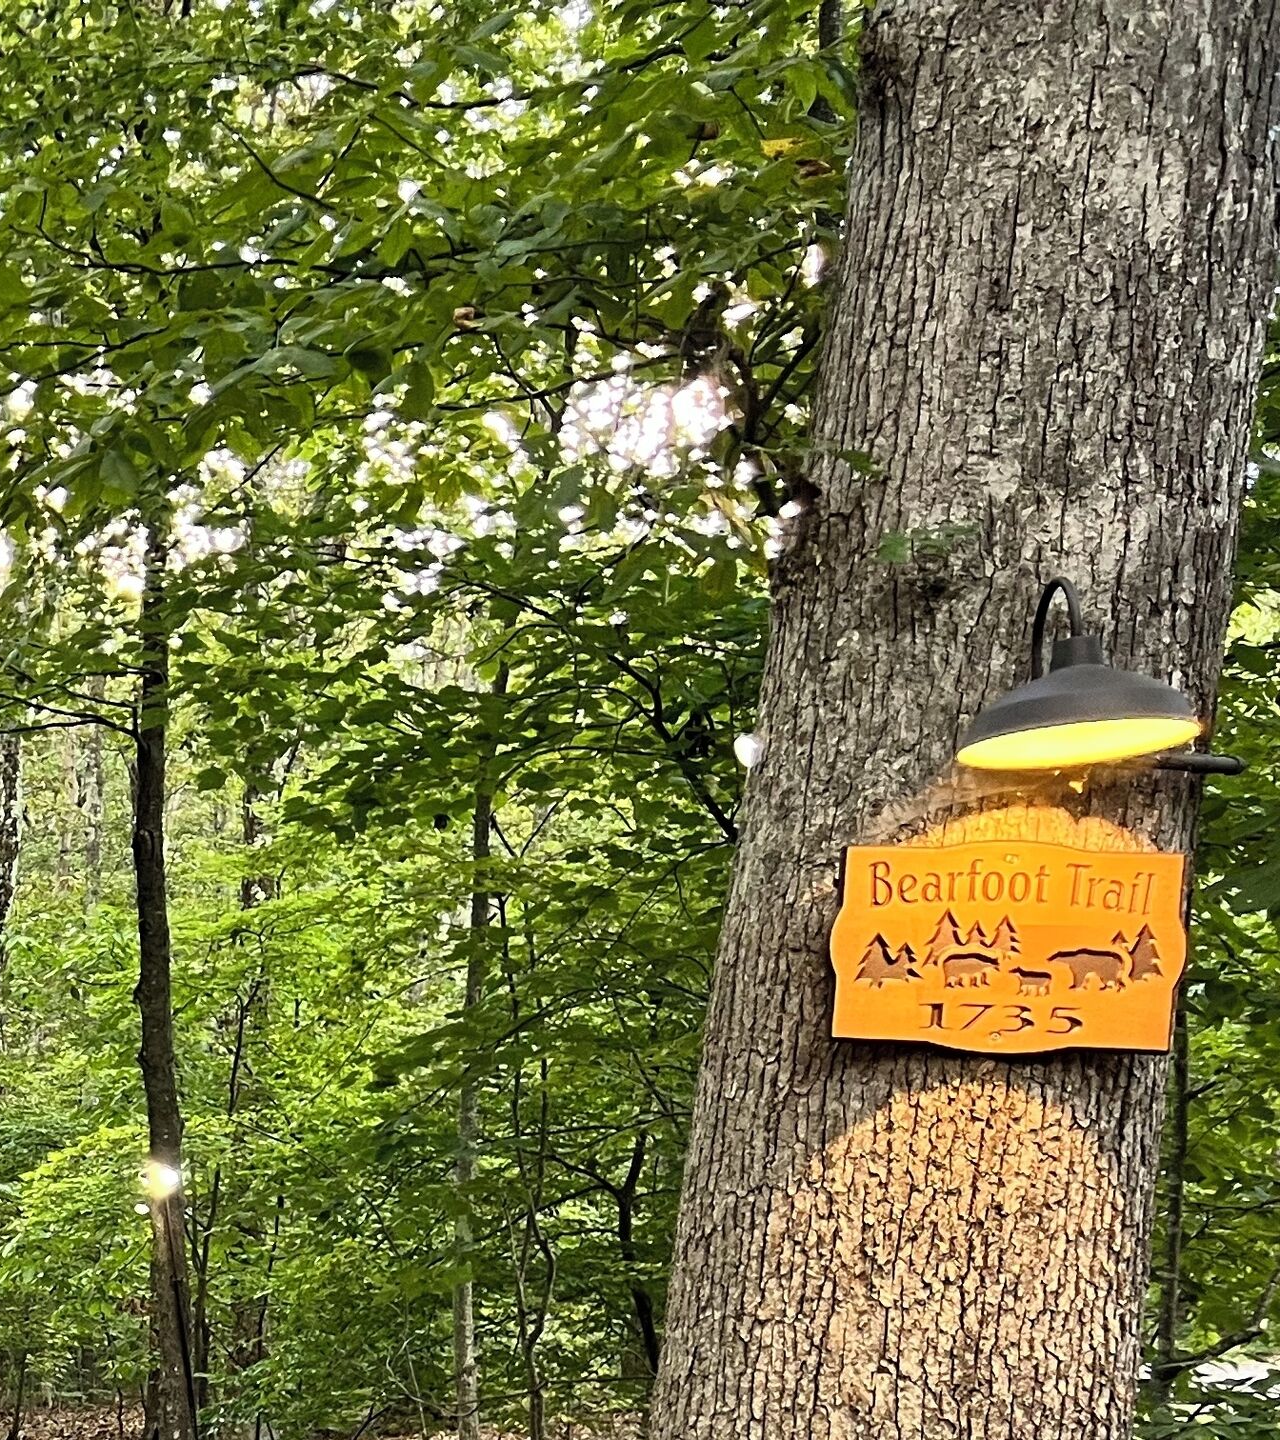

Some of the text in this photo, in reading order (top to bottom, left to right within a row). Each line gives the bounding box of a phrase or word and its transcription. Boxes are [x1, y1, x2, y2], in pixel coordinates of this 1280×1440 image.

[870, 859, 1156, 914] Bearfoot Trail
[920, 1003, 1084, 1034] 1735
